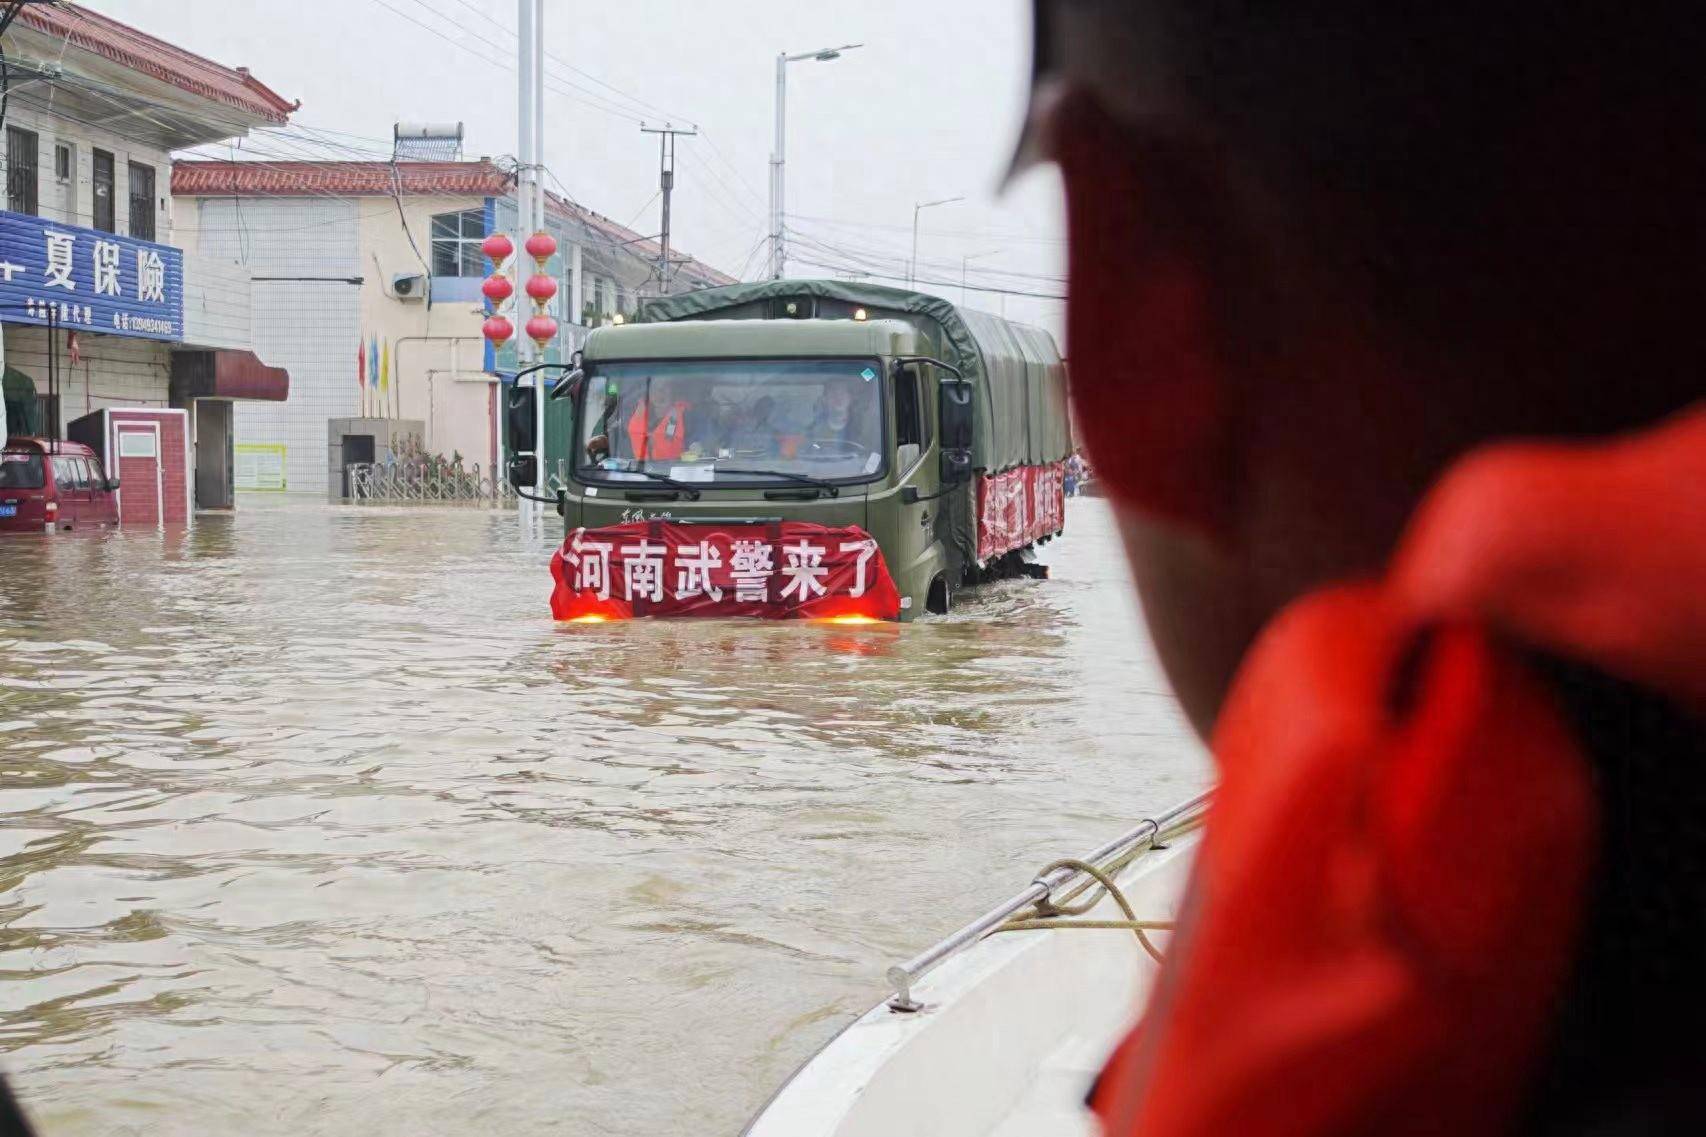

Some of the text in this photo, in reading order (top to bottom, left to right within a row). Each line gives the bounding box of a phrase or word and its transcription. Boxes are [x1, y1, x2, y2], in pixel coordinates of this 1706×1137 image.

[562, 528, 879, 603] 河南武警来了
